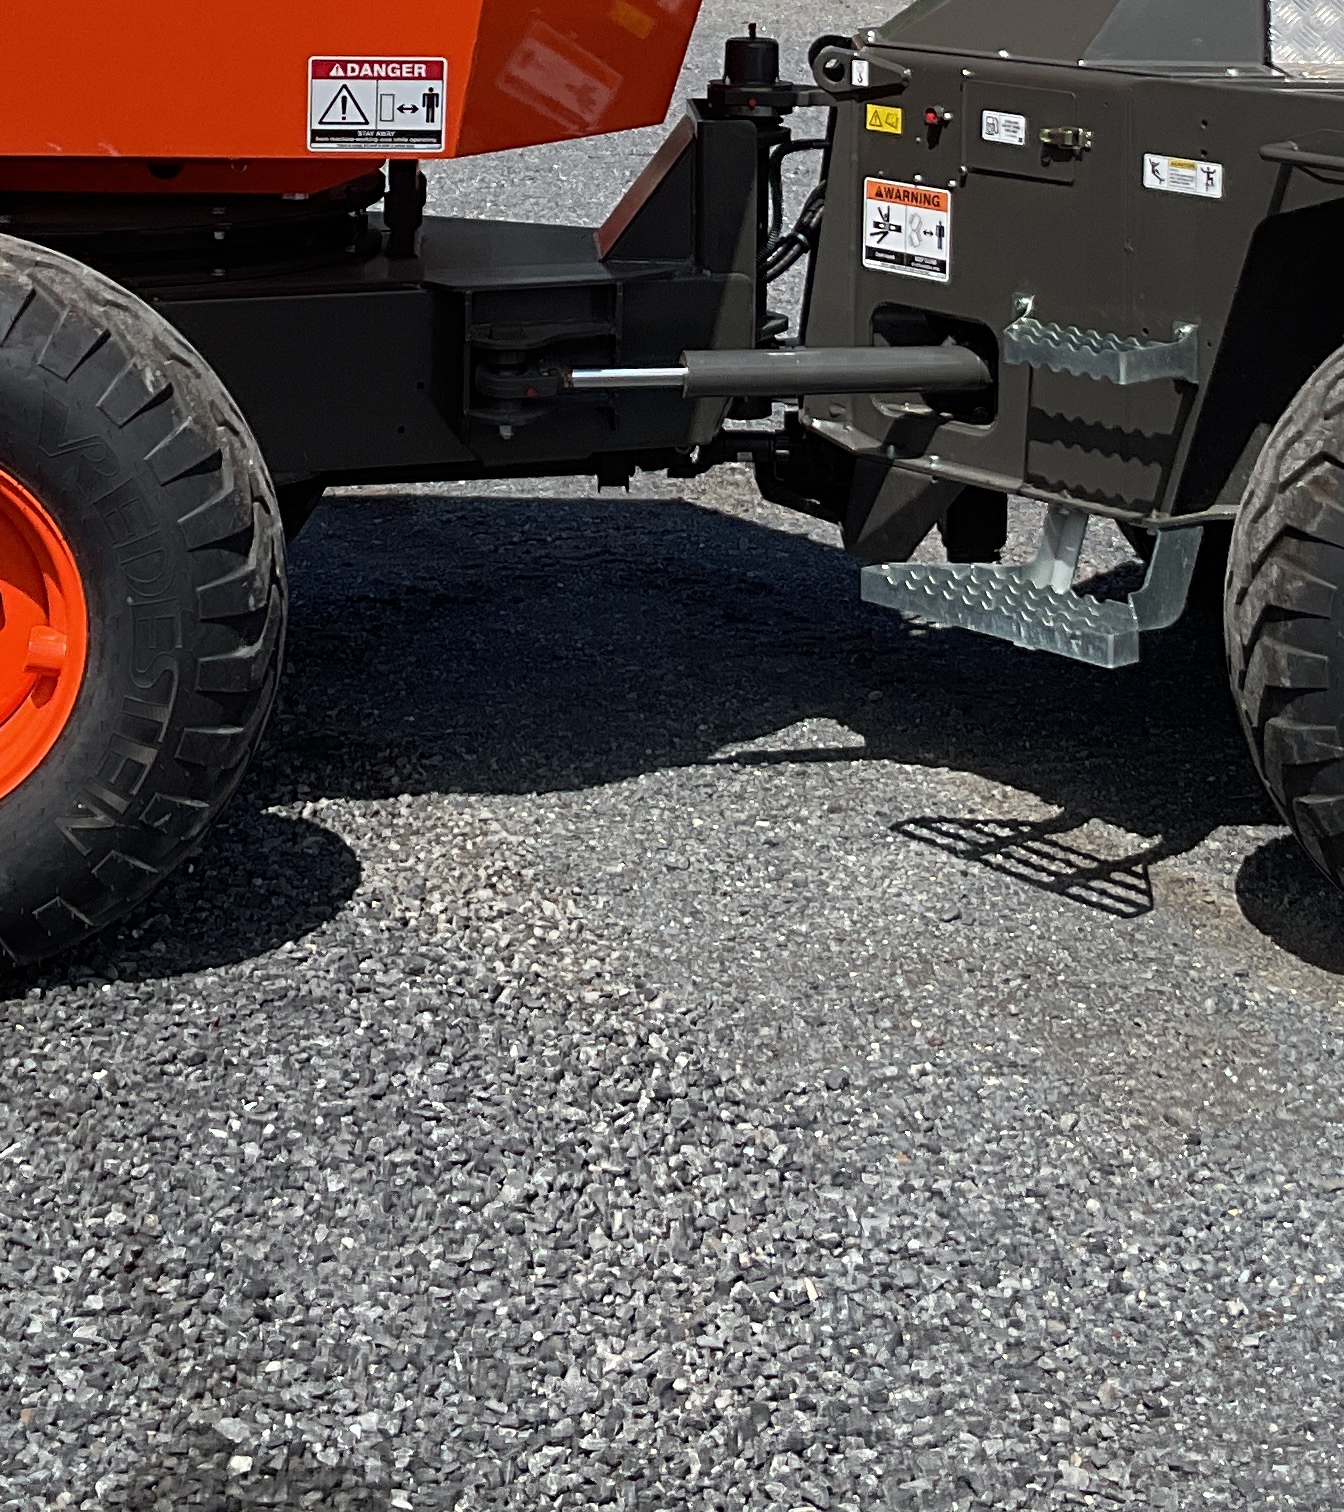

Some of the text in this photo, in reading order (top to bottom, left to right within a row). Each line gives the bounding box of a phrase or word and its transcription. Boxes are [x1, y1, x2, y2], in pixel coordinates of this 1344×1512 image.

[346, 62, 427, 78] DANGER
[883, 186, 941, 208] WARNING
[30, 418, 180, 858] VREDESTEIN
